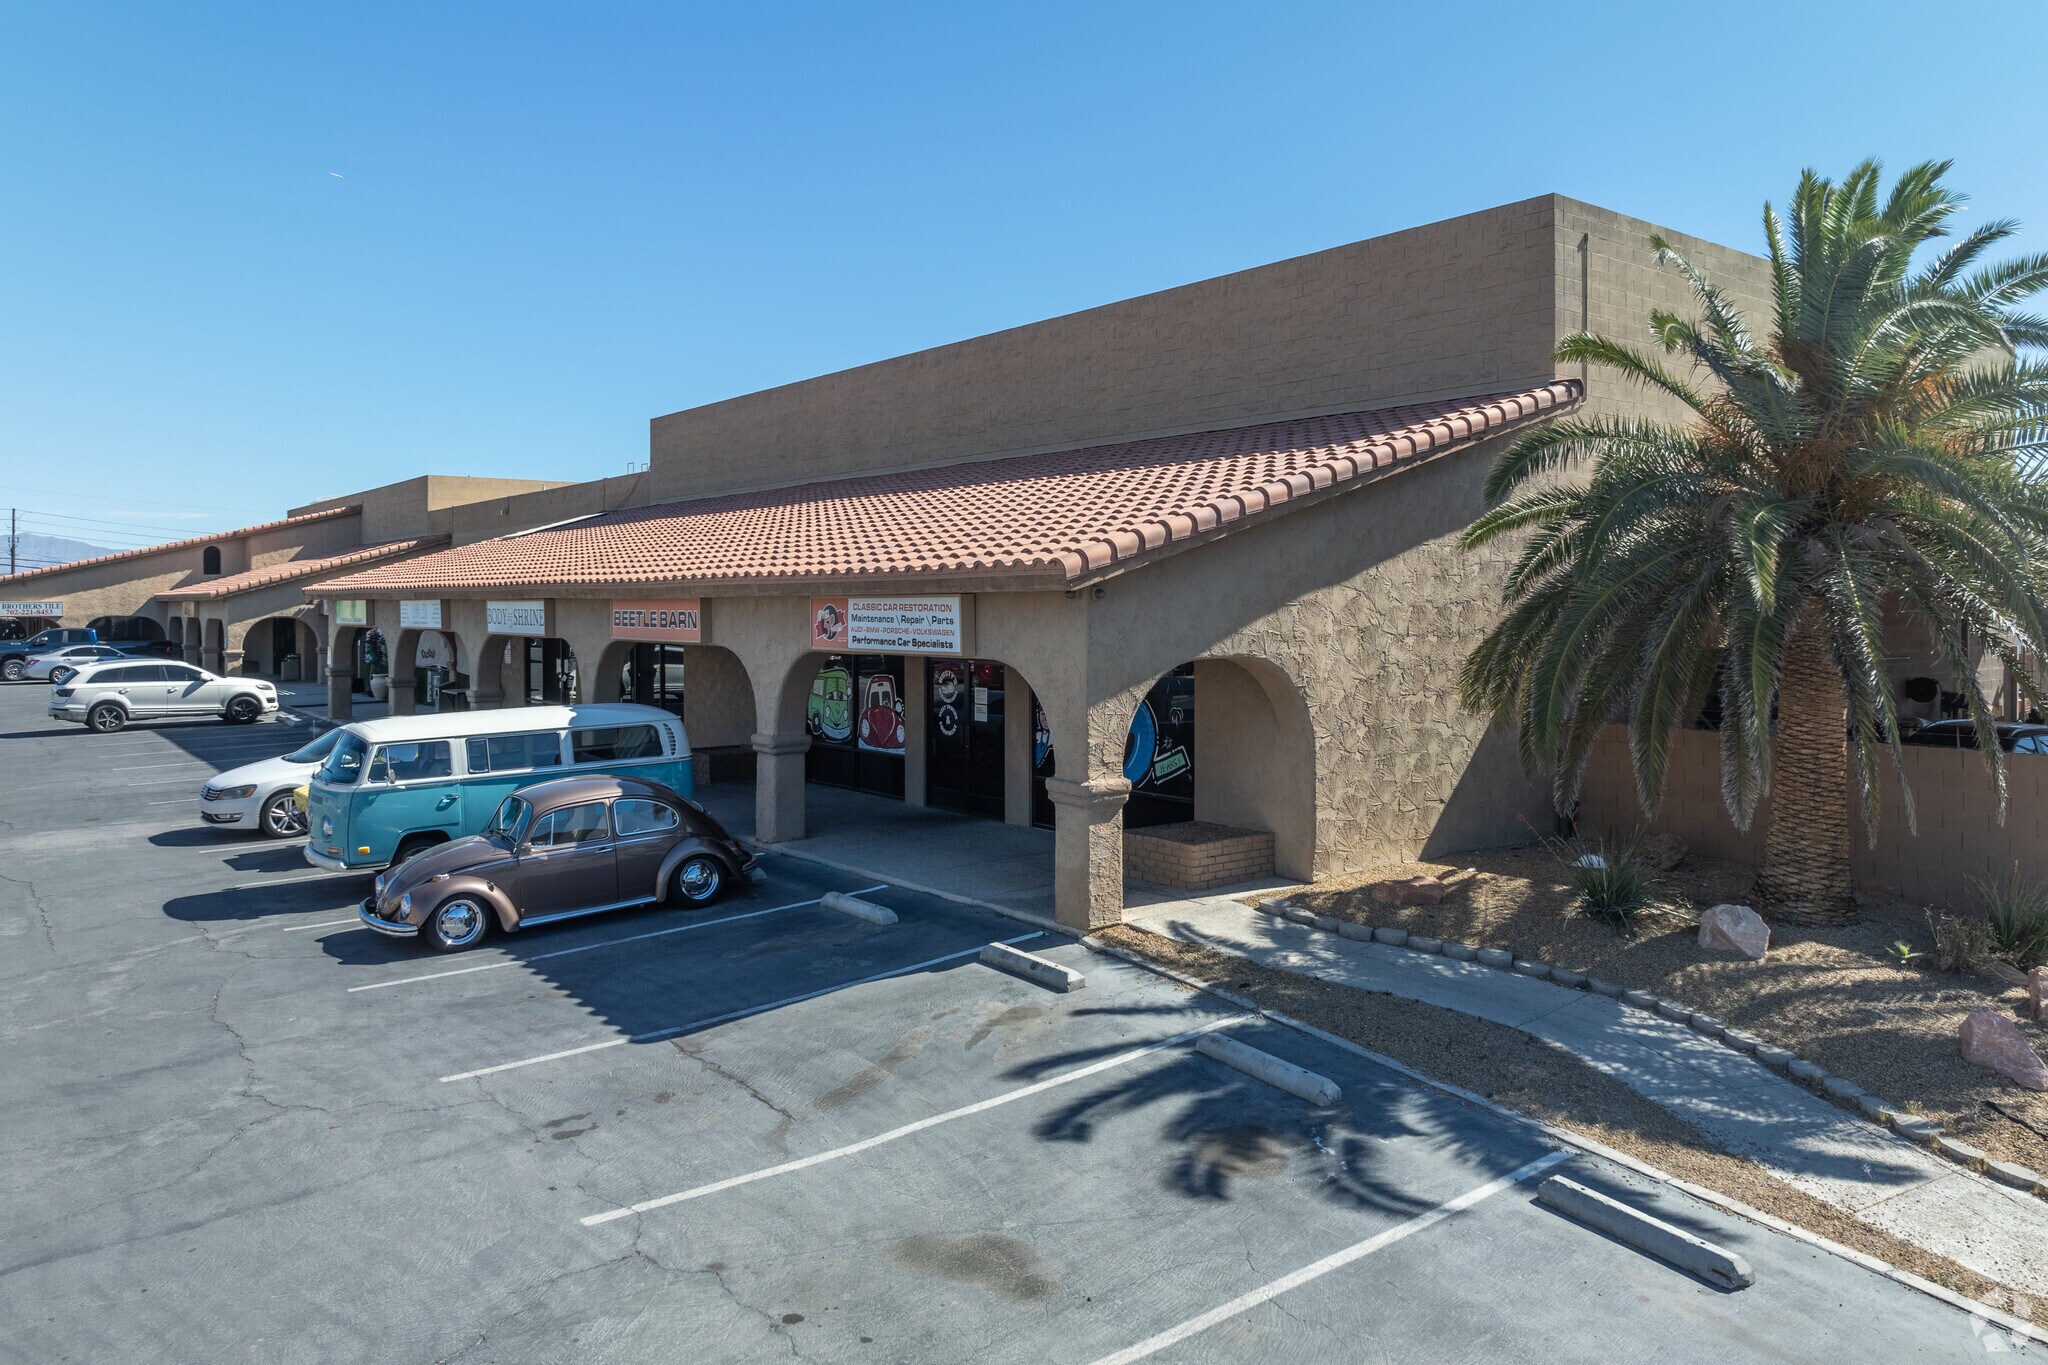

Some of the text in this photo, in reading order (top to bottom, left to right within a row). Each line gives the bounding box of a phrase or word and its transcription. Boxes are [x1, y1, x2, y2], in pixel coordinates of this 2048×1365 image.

[852, 603, 952, 613] CLASSIC CAR RESTORATION
[487, 607, 545, 627] BODY SHRINE
[613, 609, 699, 631] BEETLE BARN
[851, 614, 895, 624] Maintenance
[900, 615, 925, 626] Repair
[931, 615, 955, 626] Parts
[865, 626, 881, 634] BMW
[882, 627, 910, 635] PORSCHE
[912, 628, 956, 637] VOLKSWAGEN
[852, 635, 897, 646] Performance
[897, 637, 911, 647] Car
[911, 638, 954, 649] Specialists
